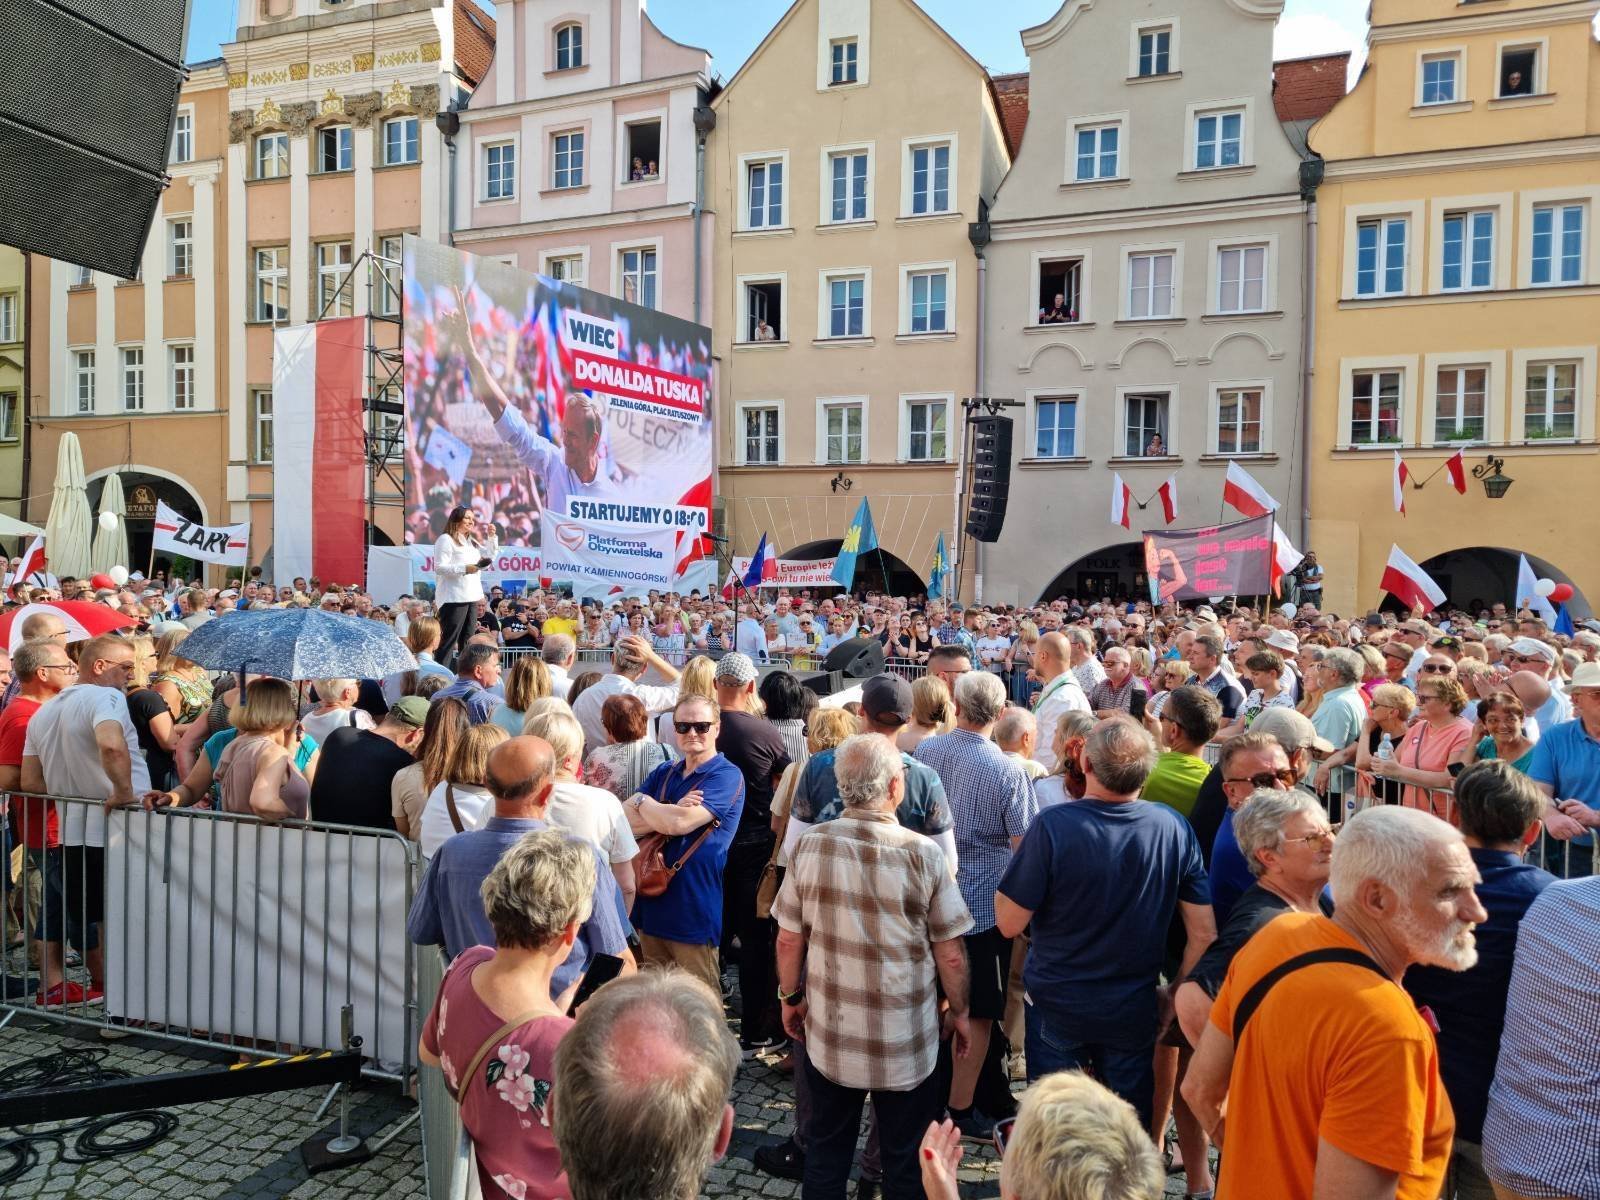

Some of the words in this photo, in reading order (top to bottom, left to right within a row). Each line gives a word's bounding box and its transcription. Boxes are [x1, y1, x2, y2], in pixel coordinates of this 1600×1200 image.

[569, 318, 615, 350] WIEC
[575, 357, 654, 395] DONALDA
[654, 376, 701, 405] TUSKA
[610, 397, 635, 411] JELENIA
[652, 405, 668, 416] PLAC
[667, 409, 700, 422] RATUSZOWY
[570, 500, 661, 524] STARTUJEMY
[662, 508, 673, 525] O
[588, 533, 647, 548] Platforma
[588, 541, 663, 559] Obywatelska
[498, 553, 541, 572] GÓRA
[546, 561, 582, 574] POWIAT
[584, 566, 668, 584] KAMIENNOGÓRSKI
[781, 563, 818, 573] Europie
[800, 574, 815, 582] nie
[815, 573, 831, 582] wie
